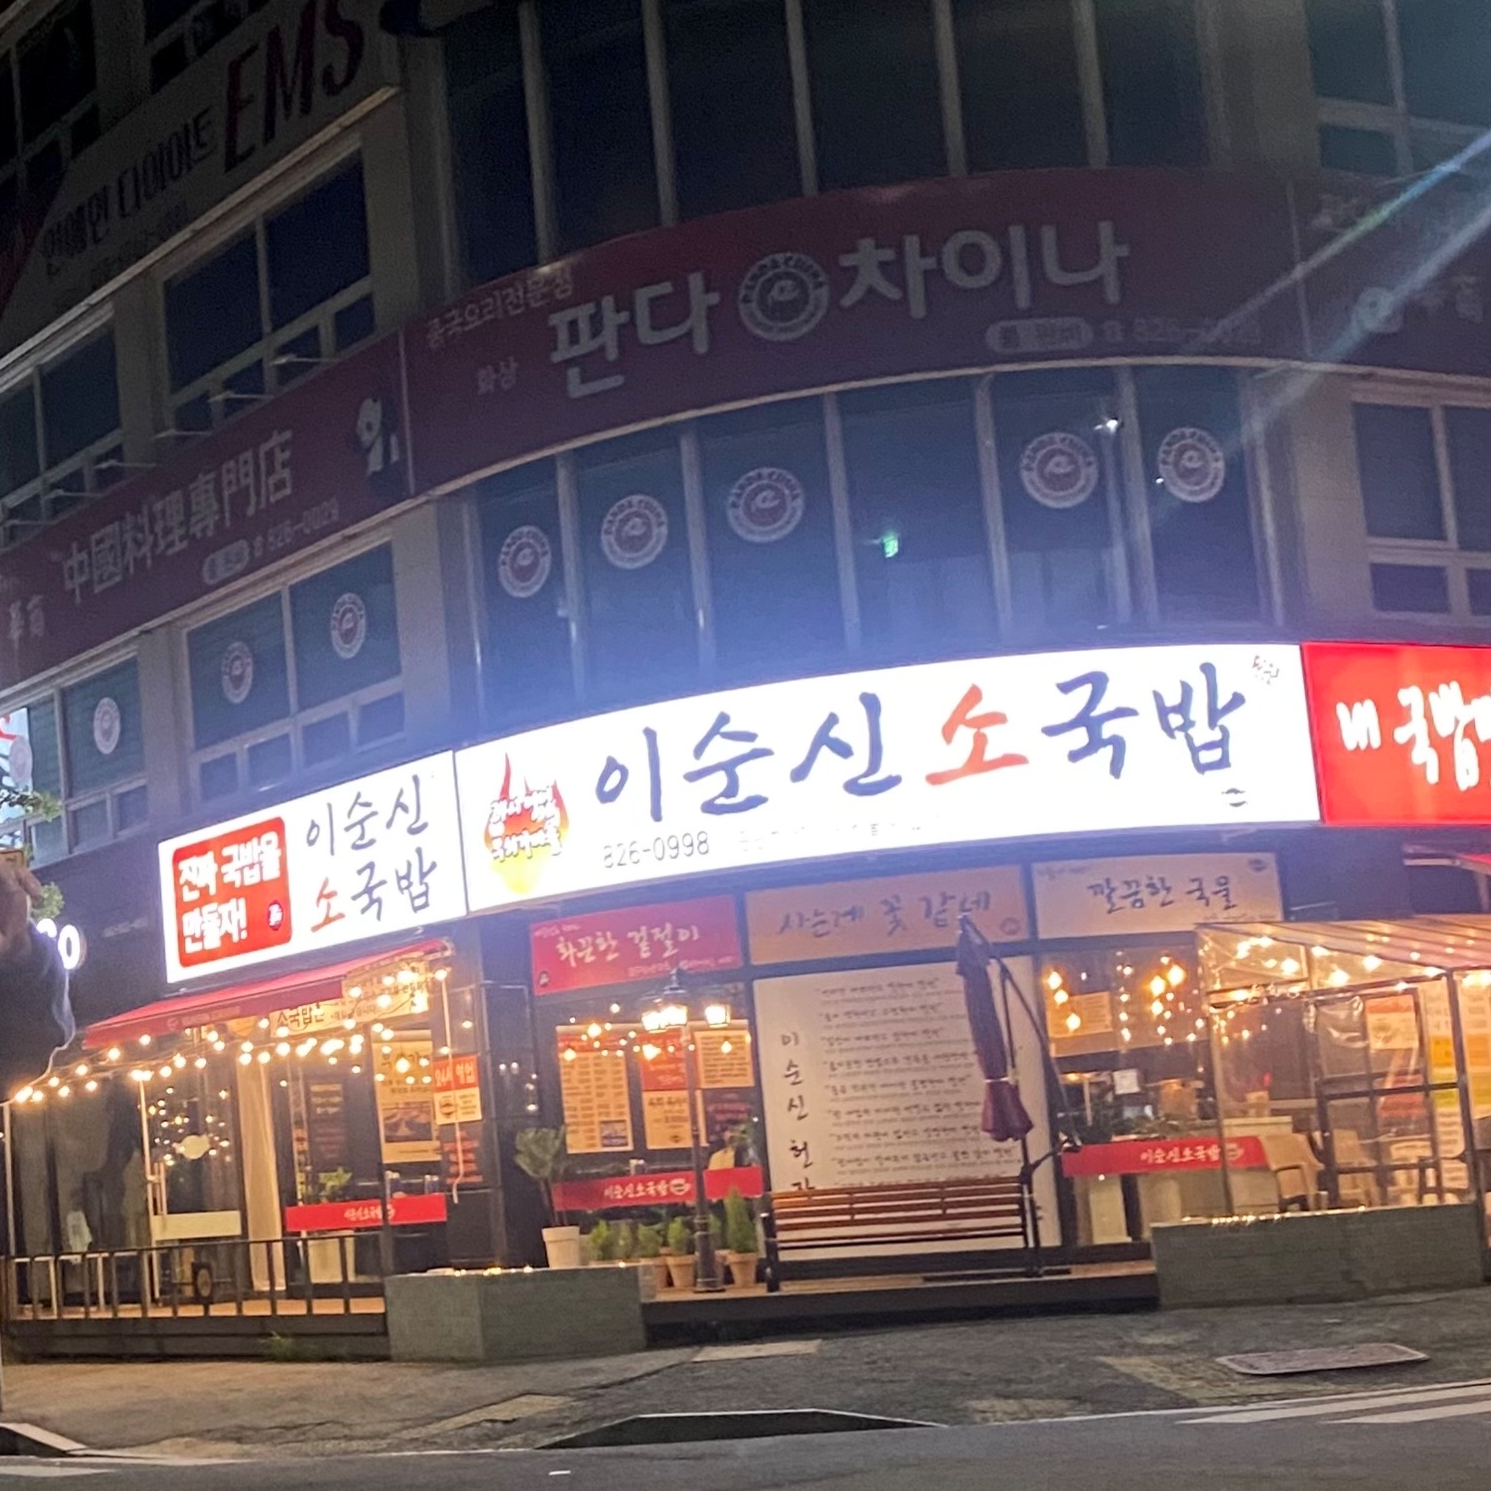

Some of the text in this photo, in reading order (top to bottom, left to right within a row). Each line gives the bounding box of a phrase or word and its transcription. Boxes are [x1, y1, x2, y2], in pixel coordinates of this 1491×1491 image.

[115, 107, 216, 219] 다이어트
[224, 0, 365, 172] EMS
[426, 266, 574, 349] 중국요리전문점
[547, 220, 1130, 399] 판다 차이나
[63, 429, 294, 606] 中國料理專門店
[1335, 680, 1491, 791] 내 국밥
[306, 773, 429, 857] 이순신
[603, 831, 710, 869] 826-0998
[221, 830, 282, 889] 국밥을
[311, 846, 438, 934] 소국밥
[1087, 875, 1238, 915] 깔끔한 국물
[182, 897, 249, 955] 만들자!
[555, 930, 621, 968] 화끈한
[627, 922, 700, 960] 겉절이
[879, 893, 908, 937] 꽃
[918, 891, 991, 929] 같네
[780, 1032, 808, 1122] 이순신
[603, 1180, 669, 1200] 이순신소국밥
[1139, 1147, 1222, 1164] 이순신소국밥
